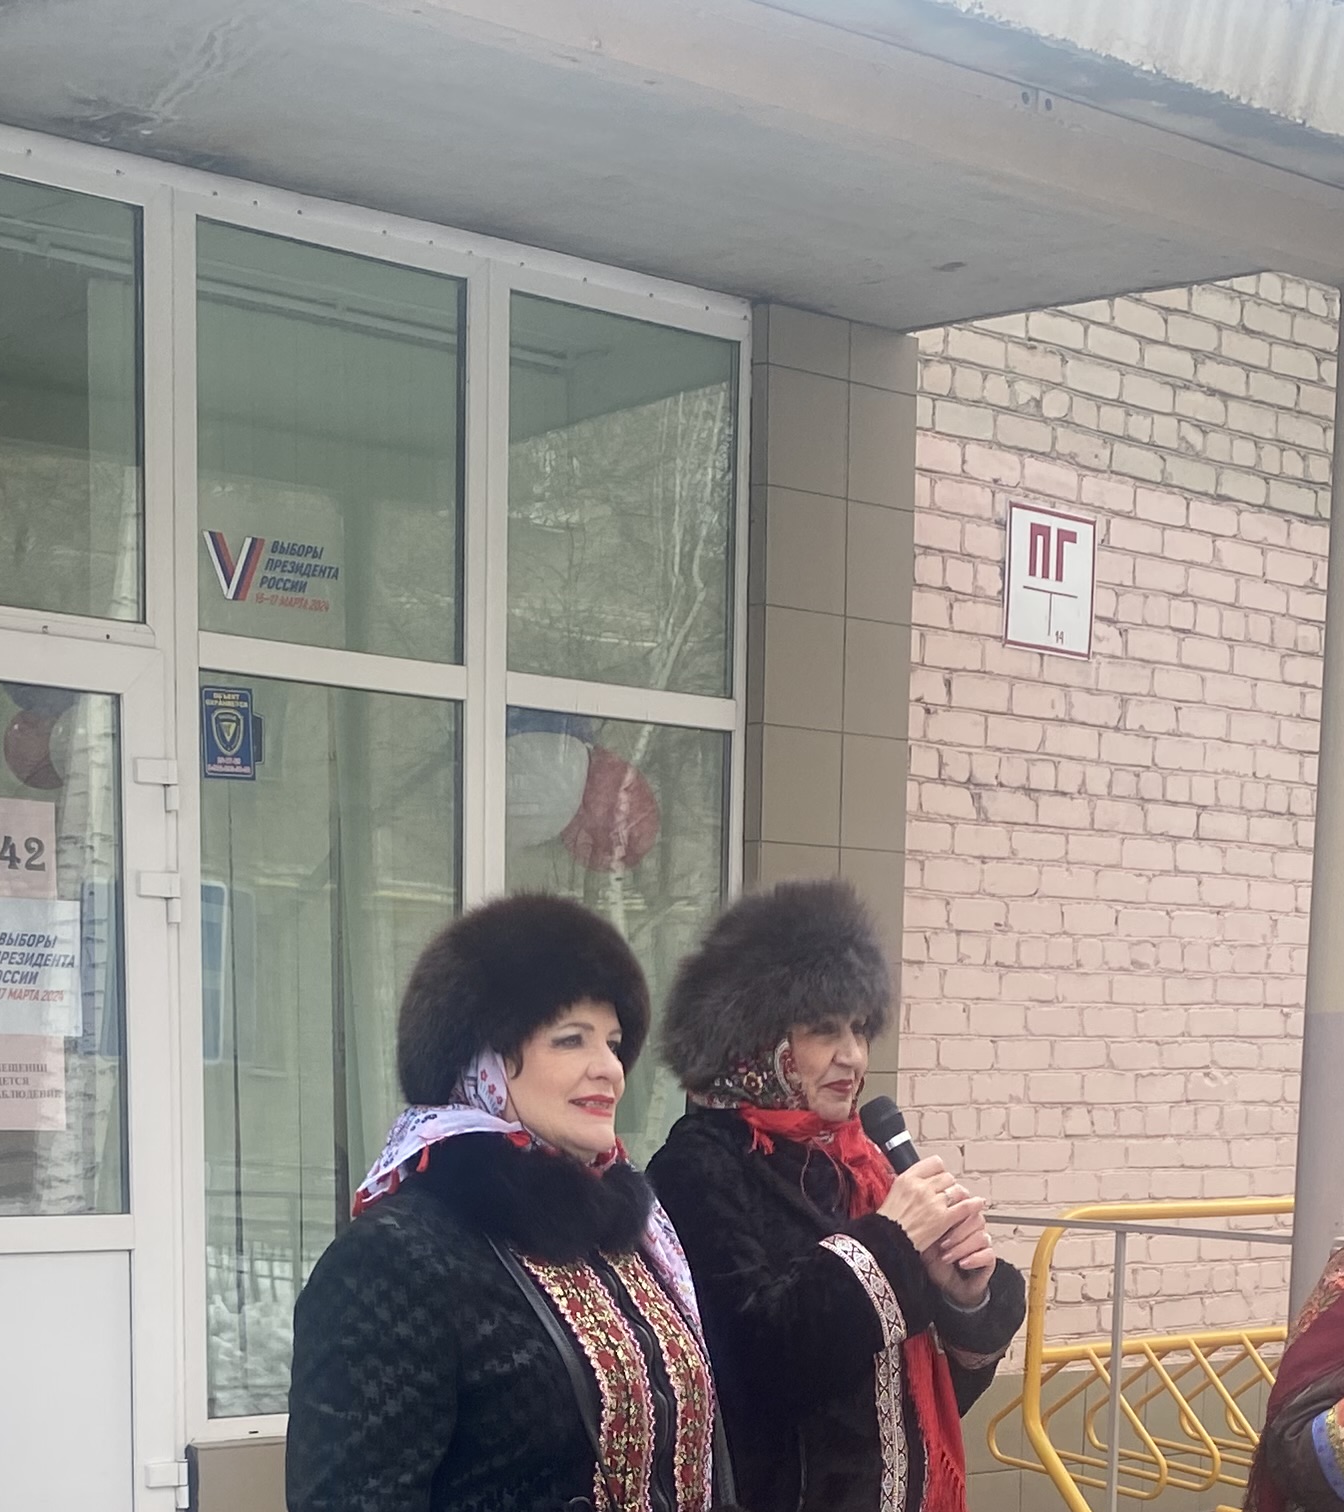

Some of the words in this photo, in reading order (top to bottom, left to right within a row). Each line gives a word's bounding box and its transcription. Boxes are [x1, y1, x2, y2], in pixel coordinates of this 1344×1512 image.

[271, 540, 324, 559] ВЫБОРЫ
[1028, 522, 1077, 582] ПГ
[264, 558, 339, 580] ПРЕЗИДЕНТА
[259, 575, 308, 593] РОССИИ
[7, 989, 40, 1001] МАРТА
